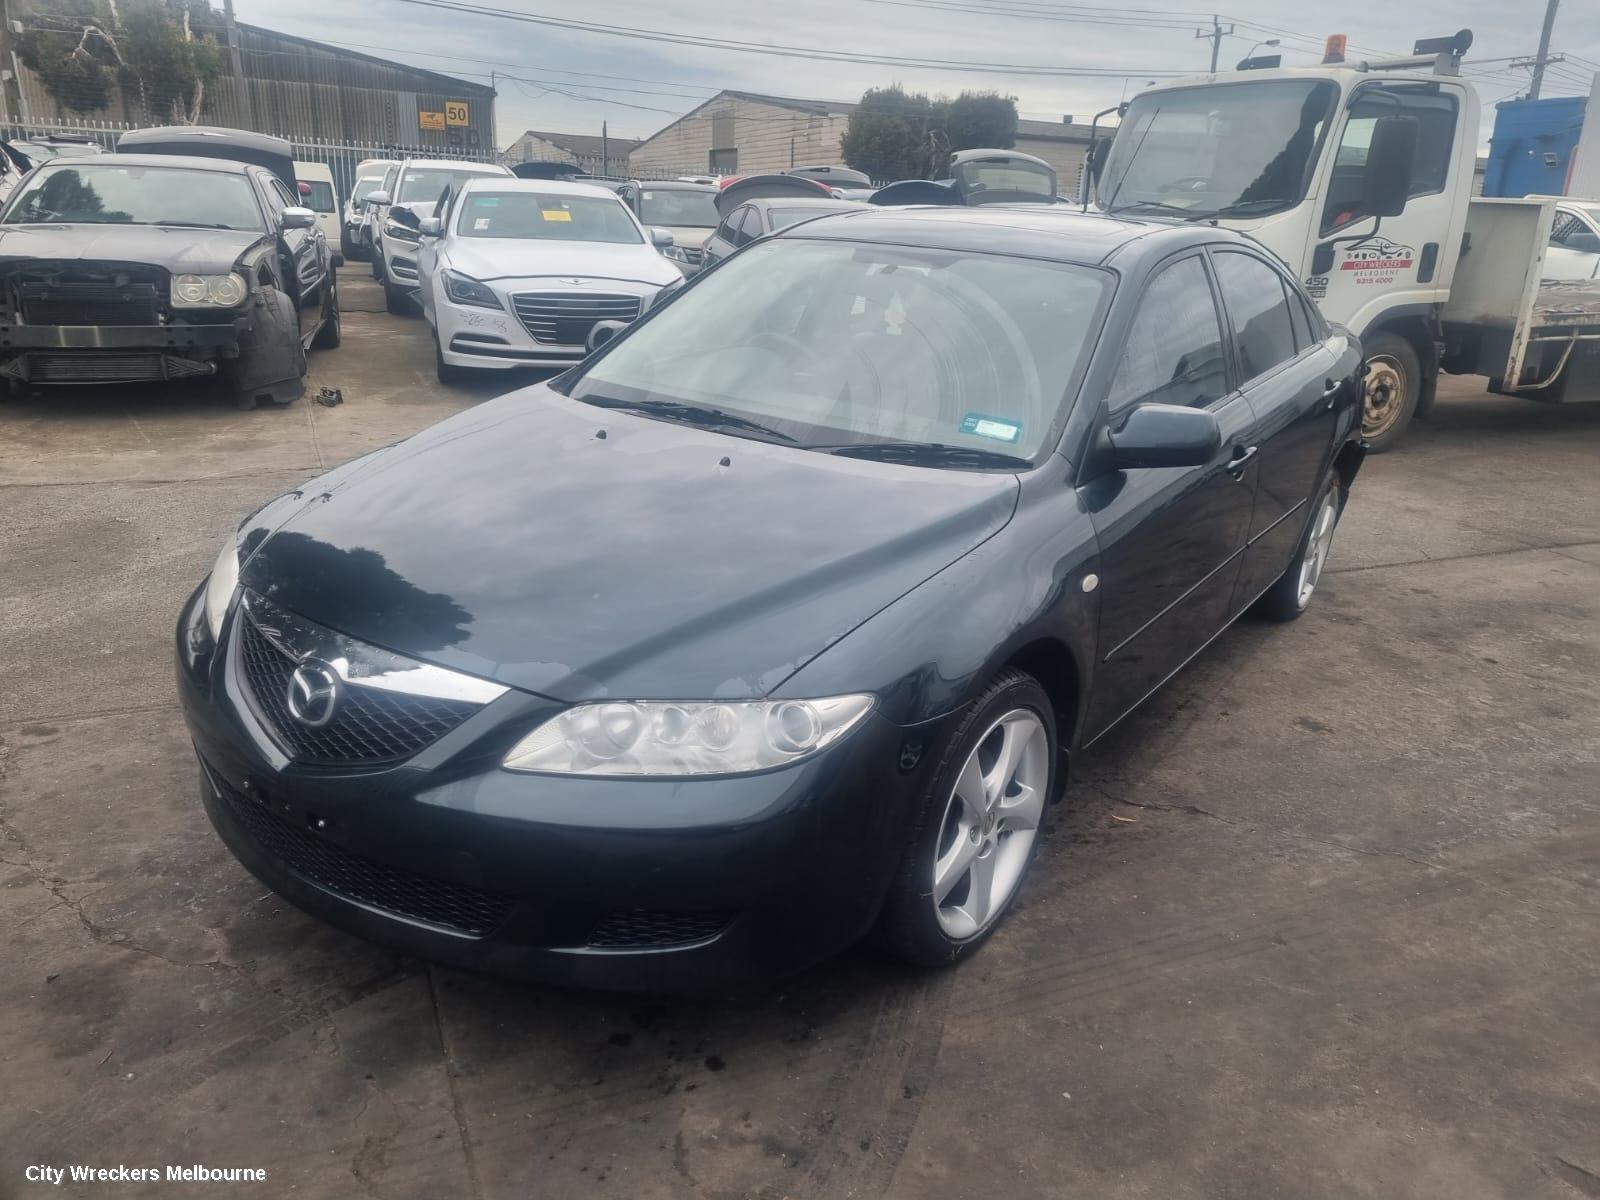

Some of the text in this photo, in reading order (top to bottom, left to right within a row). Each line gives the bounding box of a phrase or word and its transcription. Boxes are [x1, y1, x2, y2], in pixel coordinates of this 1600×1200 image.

[448, 107, 466, 121] 50
[1353, 261, 1369, 269] CITY
[1353, 269, 1399, 277] MELBOURNE
[1305, 277, 1329, 286] 450
